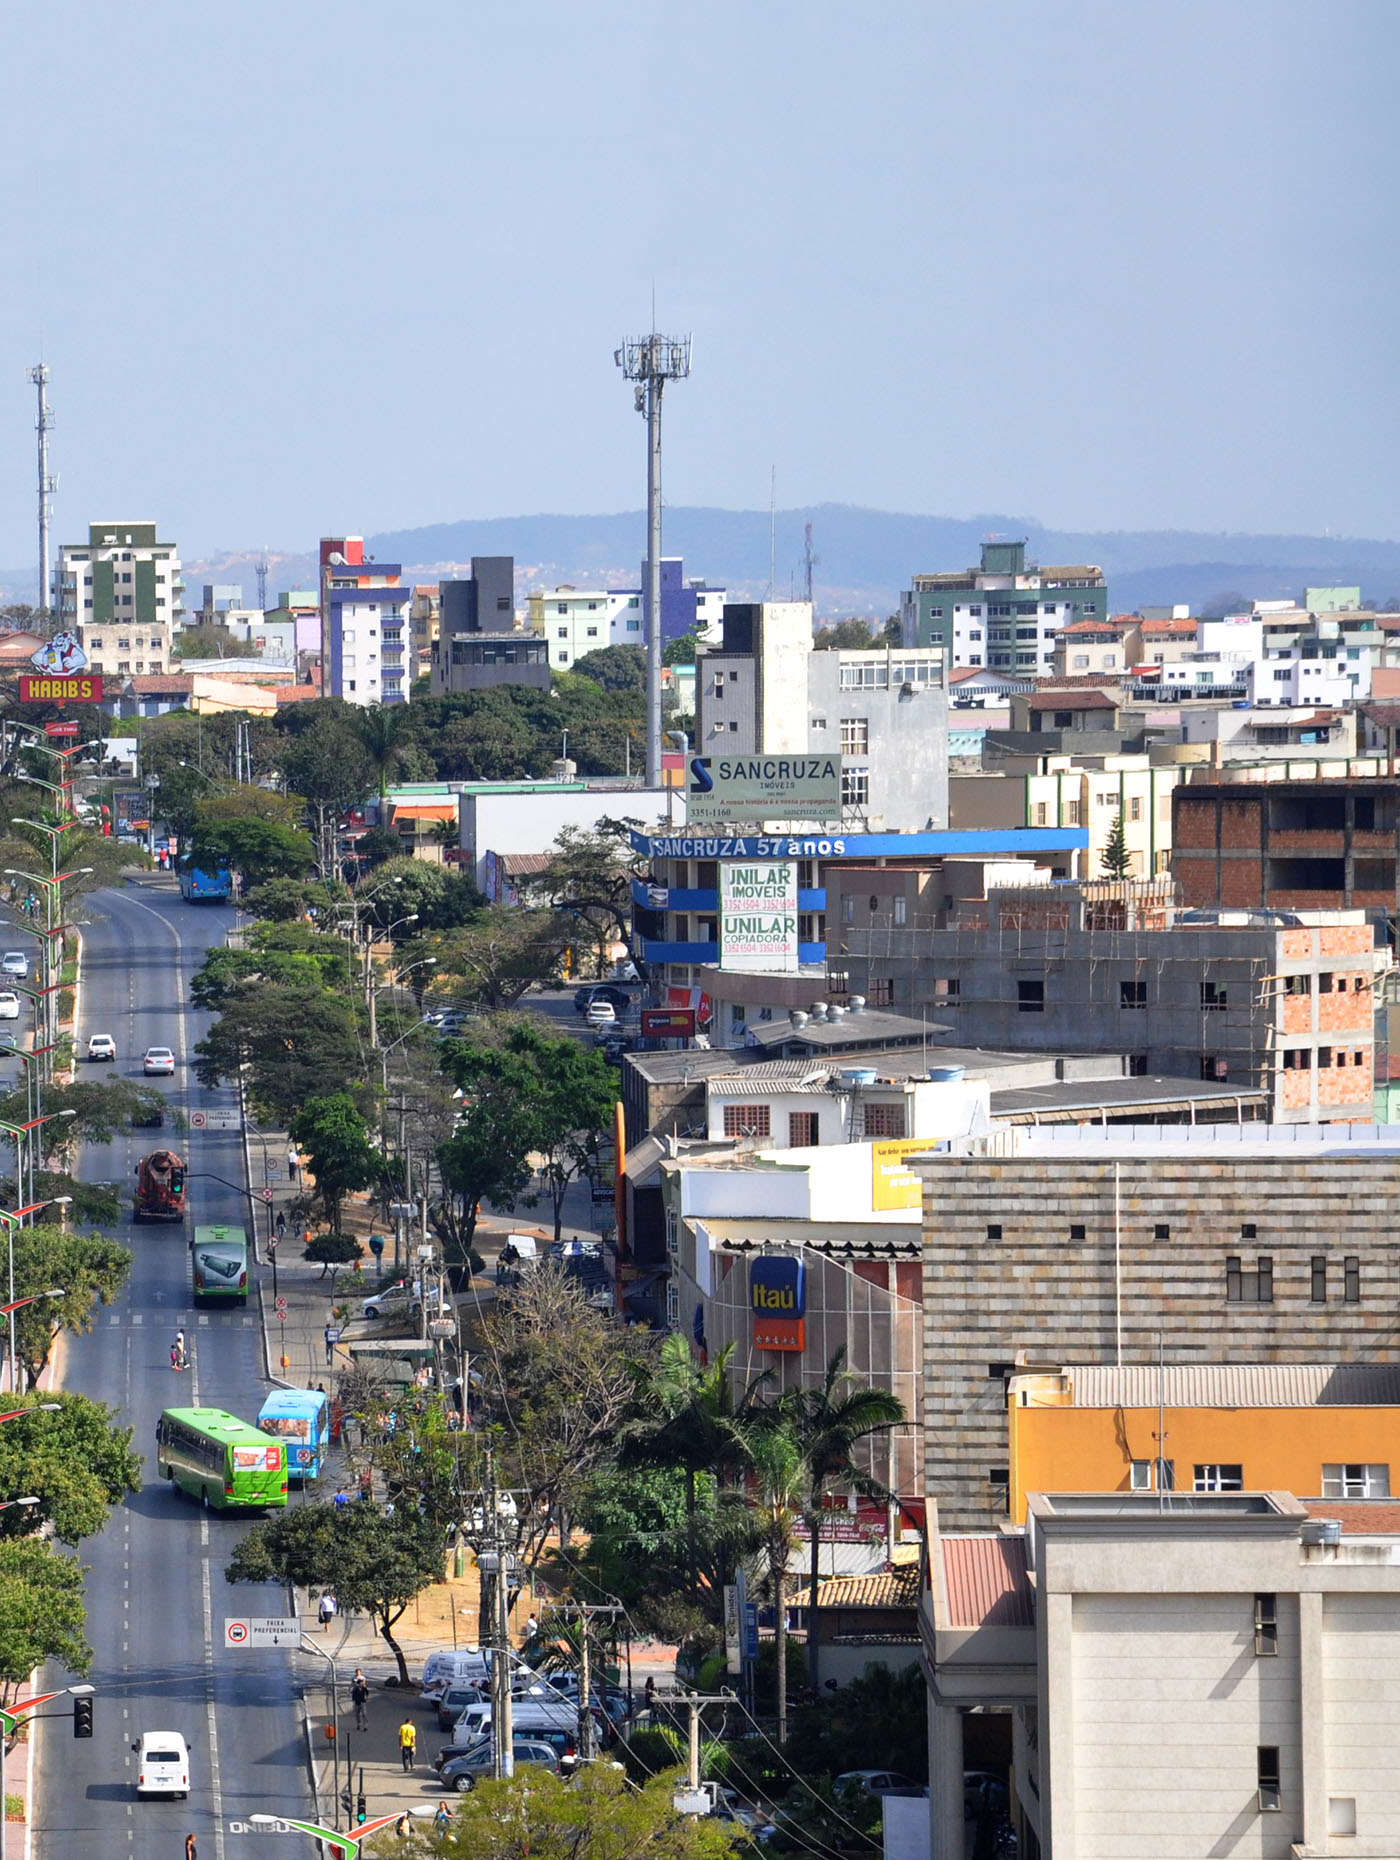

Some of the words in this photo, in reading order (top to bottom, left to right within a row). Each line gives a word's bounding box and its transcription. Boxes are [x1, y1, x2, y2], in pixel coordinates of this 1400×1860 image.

[29, 680, 92, 698] HABIB'S
[719, 761, 836, 780] SANCRUZA
[760, 781, 795, 789] IMÓVEIS
[690, 809, 731, 817] 3351-1160
[783, 809, 836, 817] sancruza.com
[657, 839, 747, 857] SANCRUZA
[757, 839, 783, 856] 57
[788, 840, 846, 856] anos
[732, 886, 786, 898] IMOVEIS
[724, 917, 796, 934] UNILAR
[724, 934, 788, 943] COPIADORA
[753, 1284, 794, 1309] Itaú
